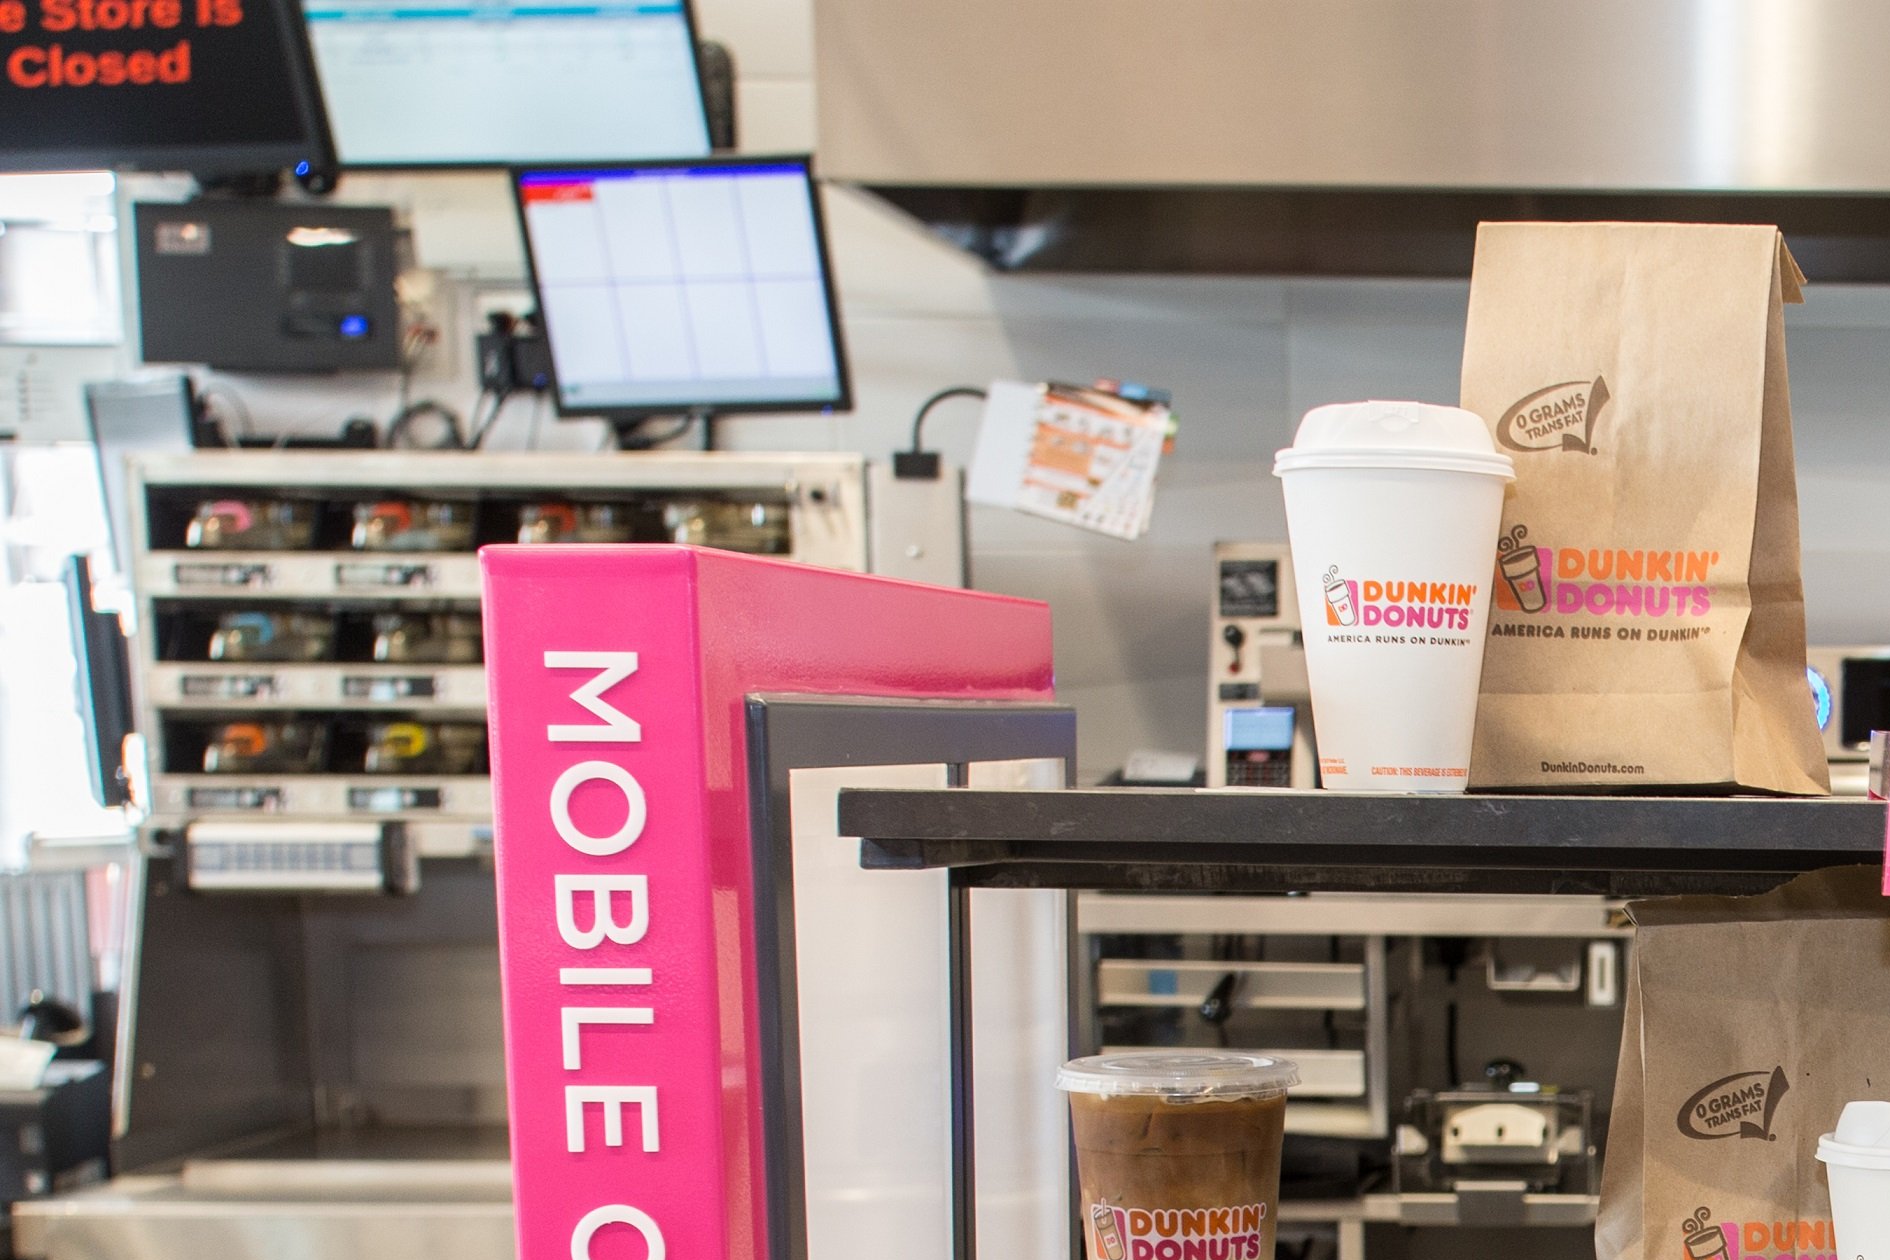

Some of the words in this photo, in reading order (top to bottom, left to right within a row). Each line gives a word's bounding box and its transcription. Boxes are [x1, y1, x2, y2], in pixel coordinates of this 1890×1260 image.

[41, 0, 183, 31] Store
[6, 39, 192, 88] Closed
[1516, 414, 1527, 429] 0
[1529, 393, 1586, 424] GRAMS
[1525, 418, 1564, 440] TRANS
[1564, 410, 1583, 427] FAT
[1557, 547, 1720, 583] DUNKIN'
[1363, 580, 1477, 606] DUNKIN'
[1556, 582, 1713, 618] DONUTS
[1363, 605, 1470, 630] DONUTS
[1491, 623, 1565, 639] AMERICA
[1570, 626, 1611, 640] RUNS
[1616, 627, 1642, 641] ON
[1328, 635, 1371, 644] AMERICA
[1376, 636, 1406, 644] RUNS
[1410, 636, 1426, 645] ON
[1541, 761, 1645, 775] DunkinDonuts.com
[544, 651, 658, 1152] MOBILE
[1696, 1103, 1707, 1119] 0
[1708, 1082, 1765, 1114] GRAMS
[1704, 1107, 1742, 1129] TRANS
[1741, 1100, 1762, 1116] FAT
[1129, 1203, 1267, 1237] DUNKIN'
